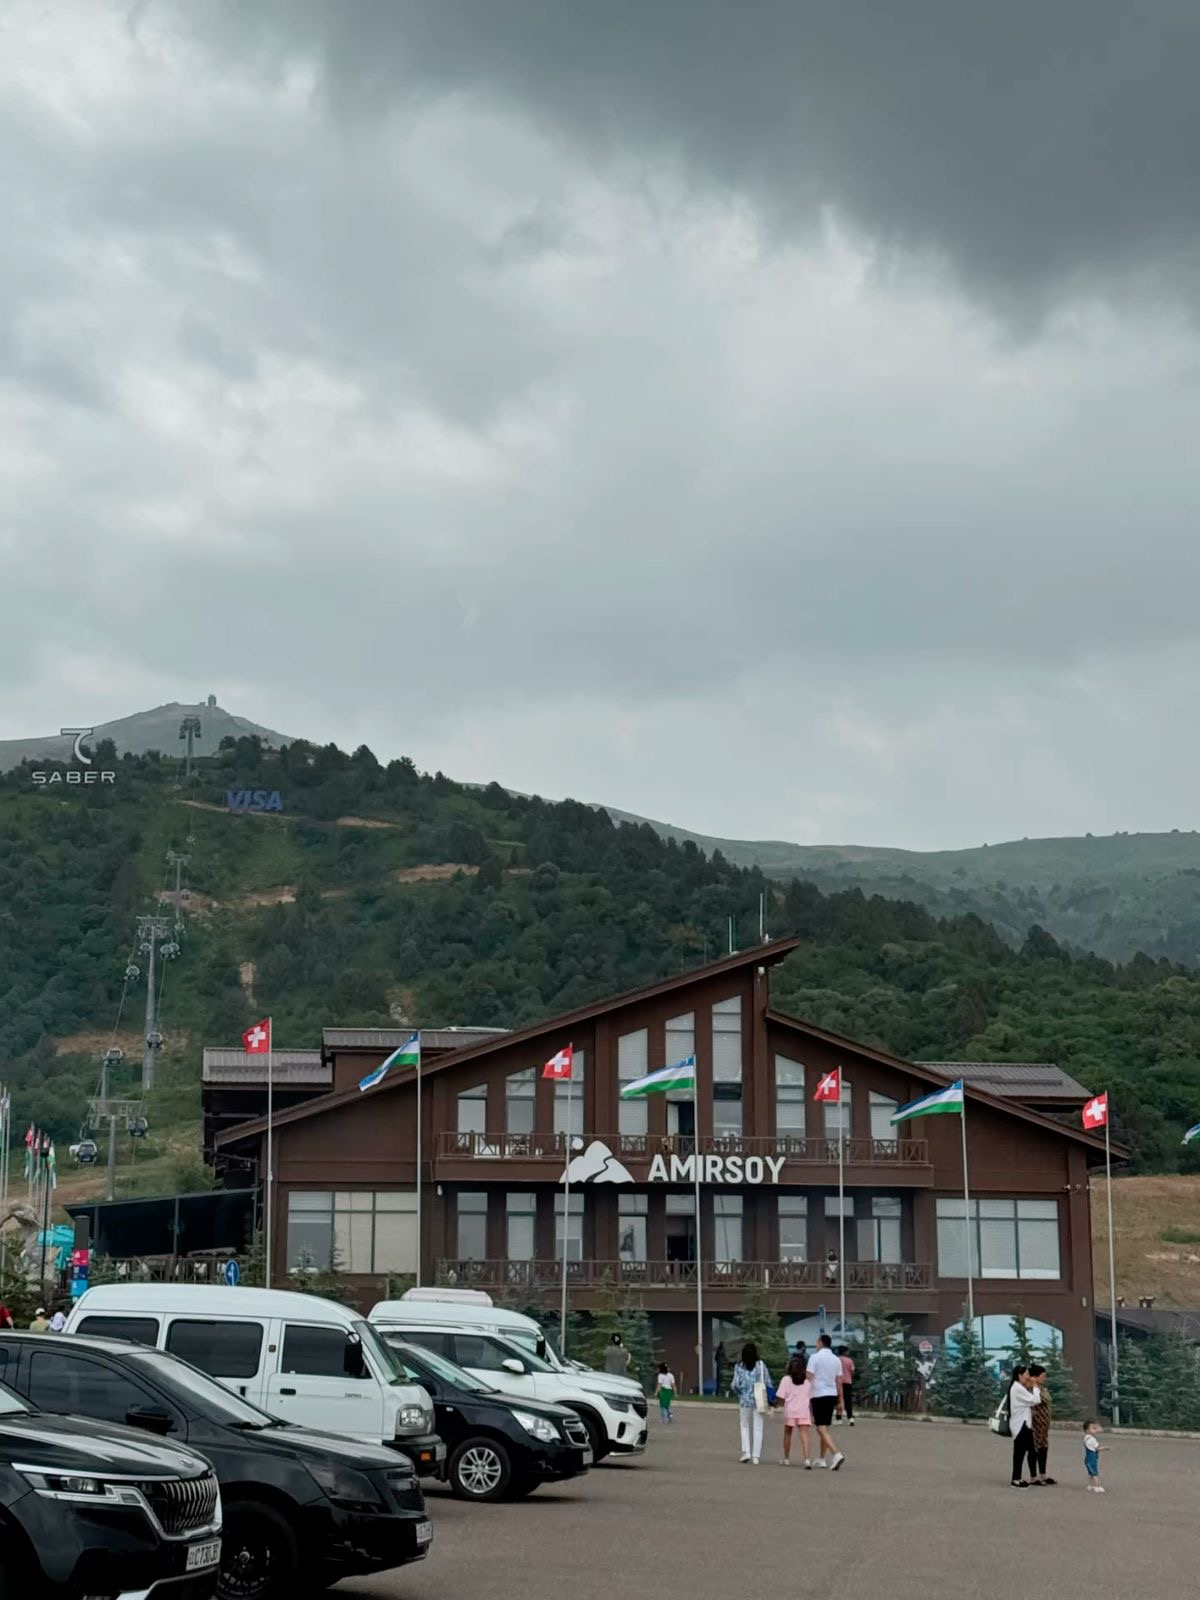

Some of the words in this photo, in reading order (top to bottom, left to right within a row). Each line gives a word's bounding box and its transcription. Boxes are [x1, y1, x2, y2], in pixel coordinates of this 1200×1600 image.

[31, 771, 116, 784] SABER
[227, 790, 284, 811] VISA
[647, 1154, 786, 1184] AMIRSOY
